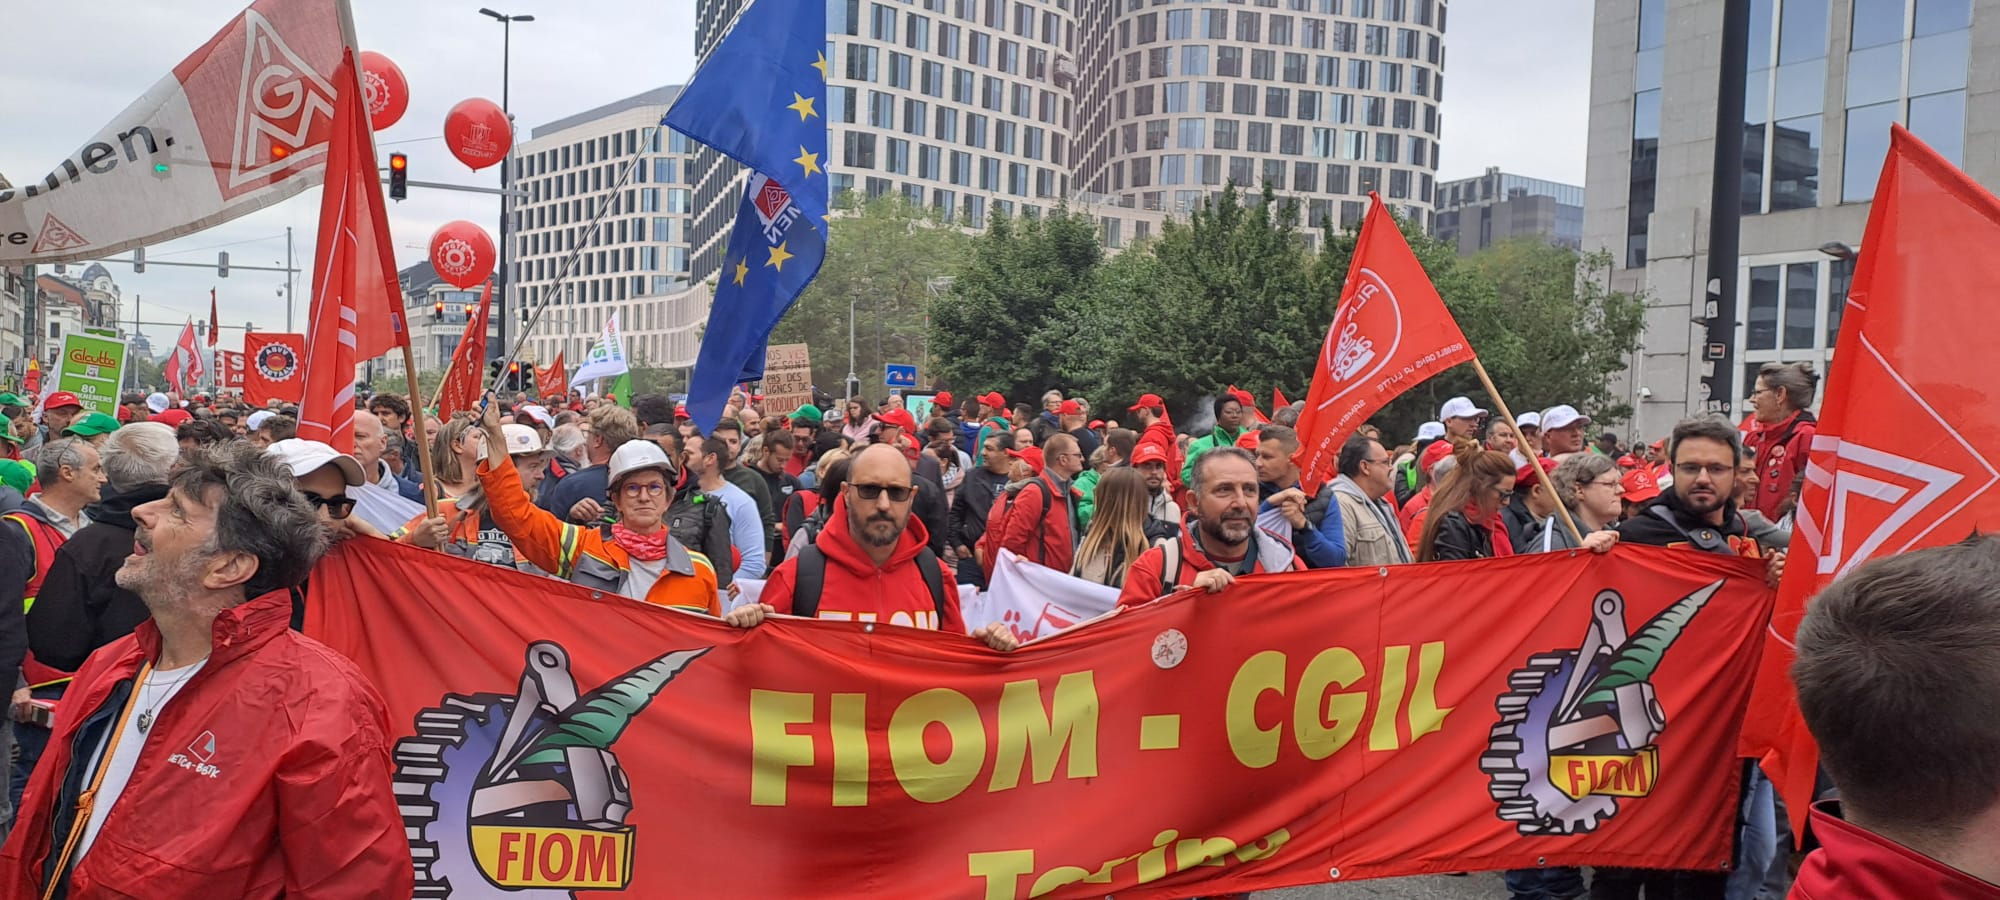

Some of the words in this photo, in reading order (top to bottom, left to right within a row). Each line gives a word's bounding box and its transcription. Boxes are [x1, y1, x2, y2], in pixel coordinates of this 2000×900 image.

[69, 347, 116, 368] Calcutta
[265, 346, 289, 355] ABVV
[81, 384, 96, 394] 80
[766, 373, 781, 384] PAS
[751, 670, 1099, 806] FIOM
[1140, 714, 1180, 750] -
[1226, 640, 1456, 769] CGIL
[1568, 755, 1647, 796] FIOM
[497, 832, 617, 882] FIOM
